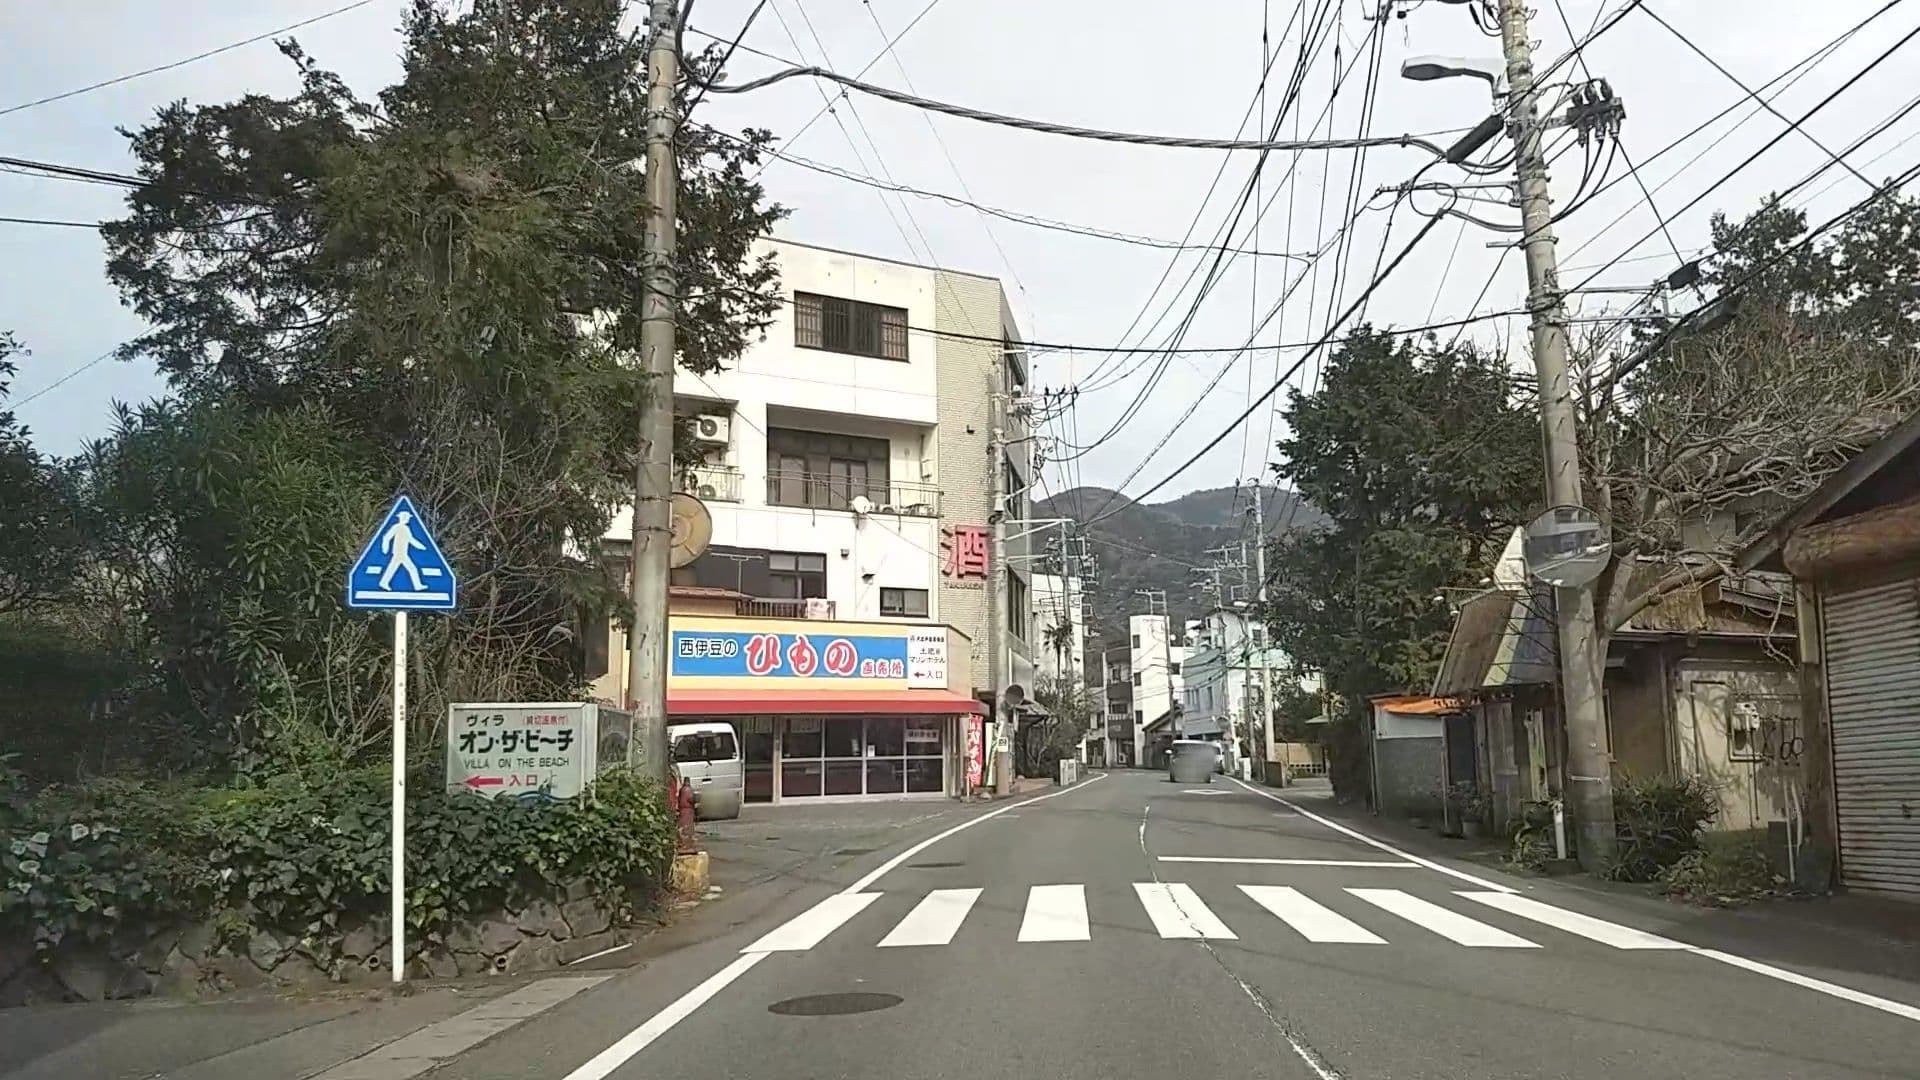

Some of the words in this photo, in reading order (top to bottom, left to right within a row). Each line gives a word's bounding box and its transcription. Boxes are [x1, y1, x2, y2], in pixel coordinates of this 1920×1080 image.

[940, 526, 989, 580] 酒
[680, 639, 736, 657] 西伊豆の
[746, 634, 857, 675] ひもの
[927, 670, 943, 679] 入口
[466, 714, 505, 727] ヴィラ
[464, 759, 490, 769] VILLA
[498, 758, 512, 768] ON
[517, 758, 535, 768] THE
[539, 757, 569, 768] BEACH
[509, 774, 538, 787] 入口
